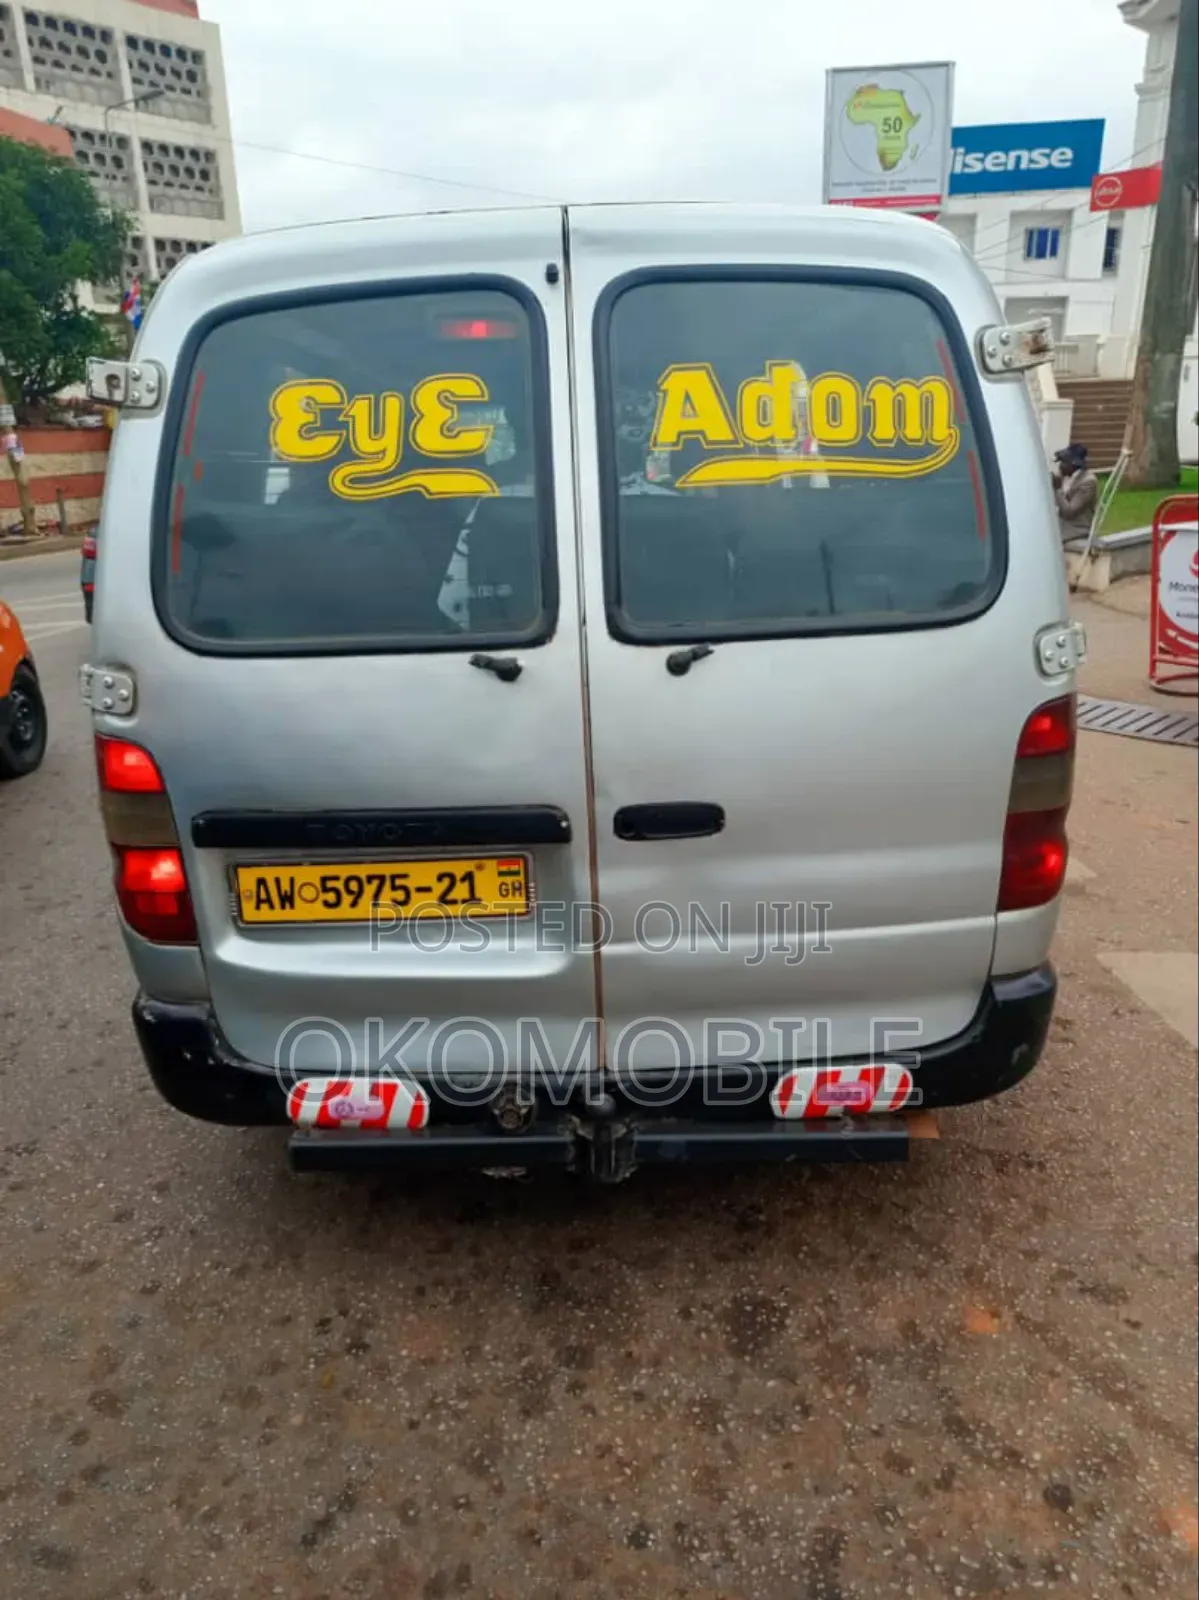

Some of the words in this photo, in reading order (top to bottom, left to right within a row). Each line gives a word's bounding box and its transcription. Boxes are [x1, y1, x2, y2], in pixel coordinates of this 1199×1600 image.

[881, 117, 903, 133] 50
[651, 360, 960, 488] Adom
[254, 877, 296, 911] AW
[318, 871, 482, 909] 5975-21
[498, 881, 525, 899] GH
